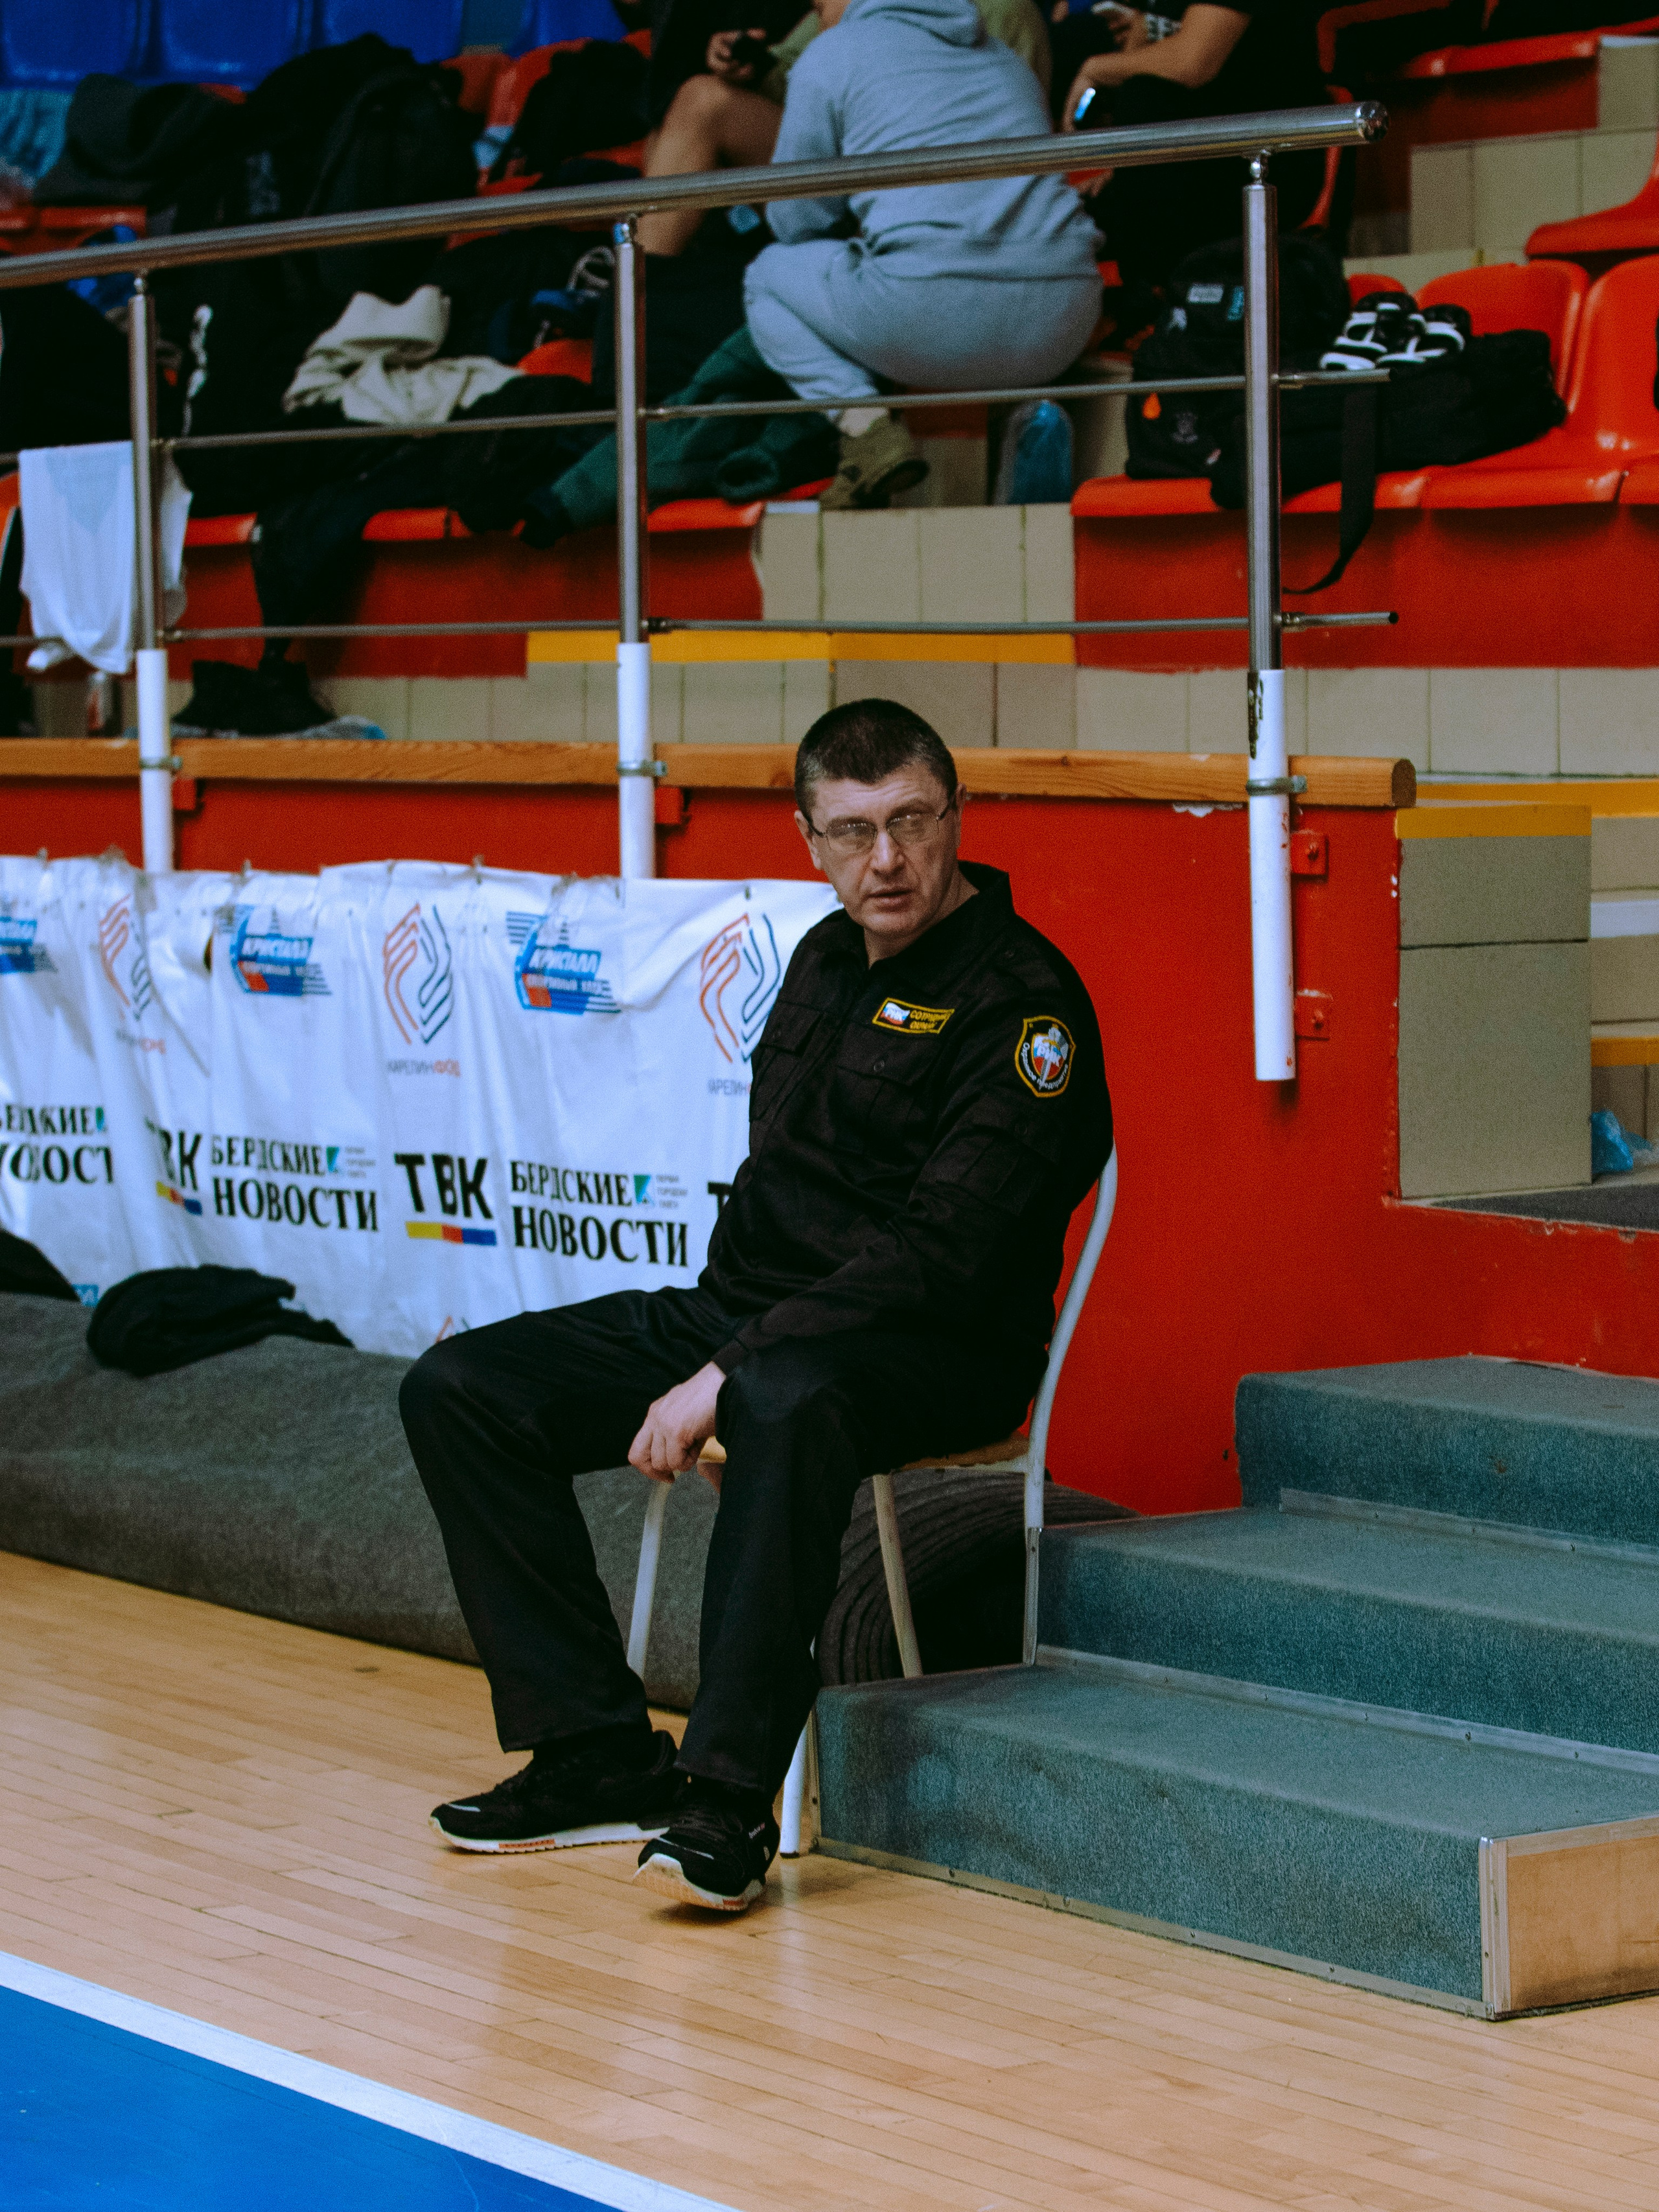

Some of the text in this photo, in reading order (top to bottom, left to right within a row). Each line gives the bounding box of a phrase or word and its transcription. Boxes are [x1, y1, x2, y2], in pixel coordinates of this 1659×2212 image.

[212, 1135, 325, 1177] БЕРДСКИЕ
[509, 1159, 632, 1207] БЕРДСКИЕ
[213, 1176, 378, 1232] НОВОСТИ
[394, 1152, 494, 1220] ТВК
[512, 1205, 688, 1268] НОВОСТИ
